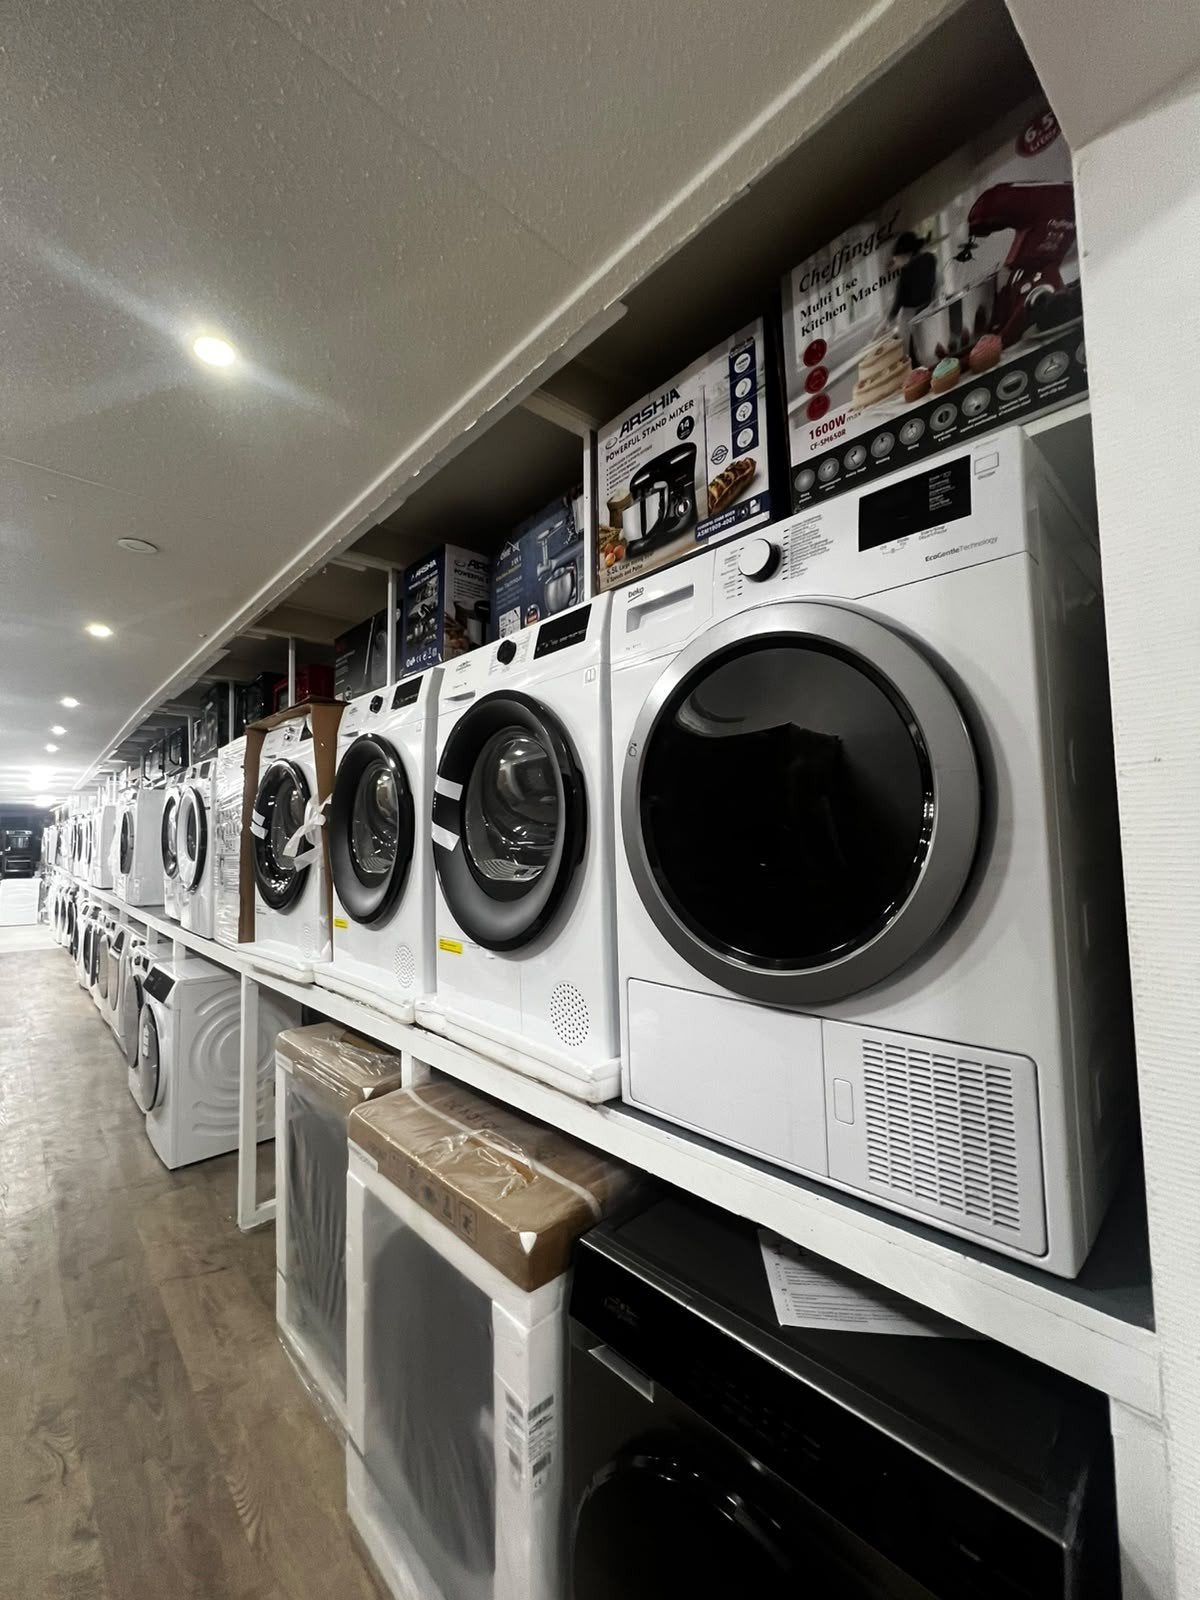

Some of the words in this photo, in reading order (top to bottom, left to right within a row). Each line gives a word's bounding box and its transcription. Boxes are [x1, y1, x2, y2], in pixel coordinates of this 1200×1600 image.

[800, 292, 832, 319] Multi
[835, 278, 858, 297] Use
[801, 303, 847, 337] Kitchen
[605, 434, 641, 462] POWERFUL
[642, 417, 667, 439] STAND
[669, 399, 695, 421] MIXER
[619, 388, 681, 438] ARSHIA
[809, 413, 847, 440] 1600W
